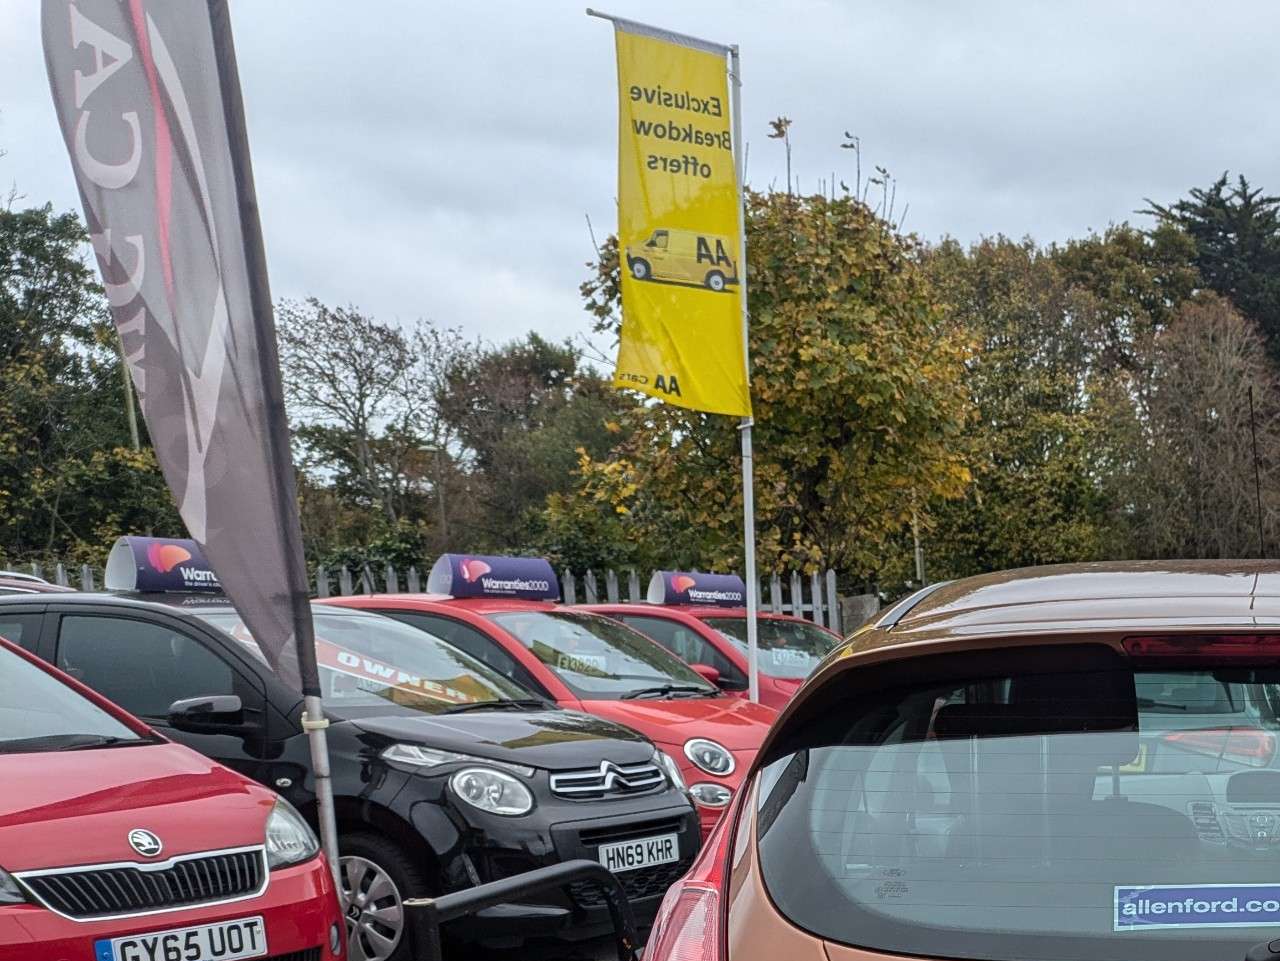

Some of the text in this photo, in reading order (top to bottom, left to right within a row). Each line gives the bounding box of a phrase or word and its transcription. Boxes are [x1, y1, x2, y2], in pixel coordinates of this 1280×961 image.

[482, 577, 549, 591] Warranties2000
[606, 838, 673, 870] HN69 KHR
[208, 921, 259, 957] UOT
